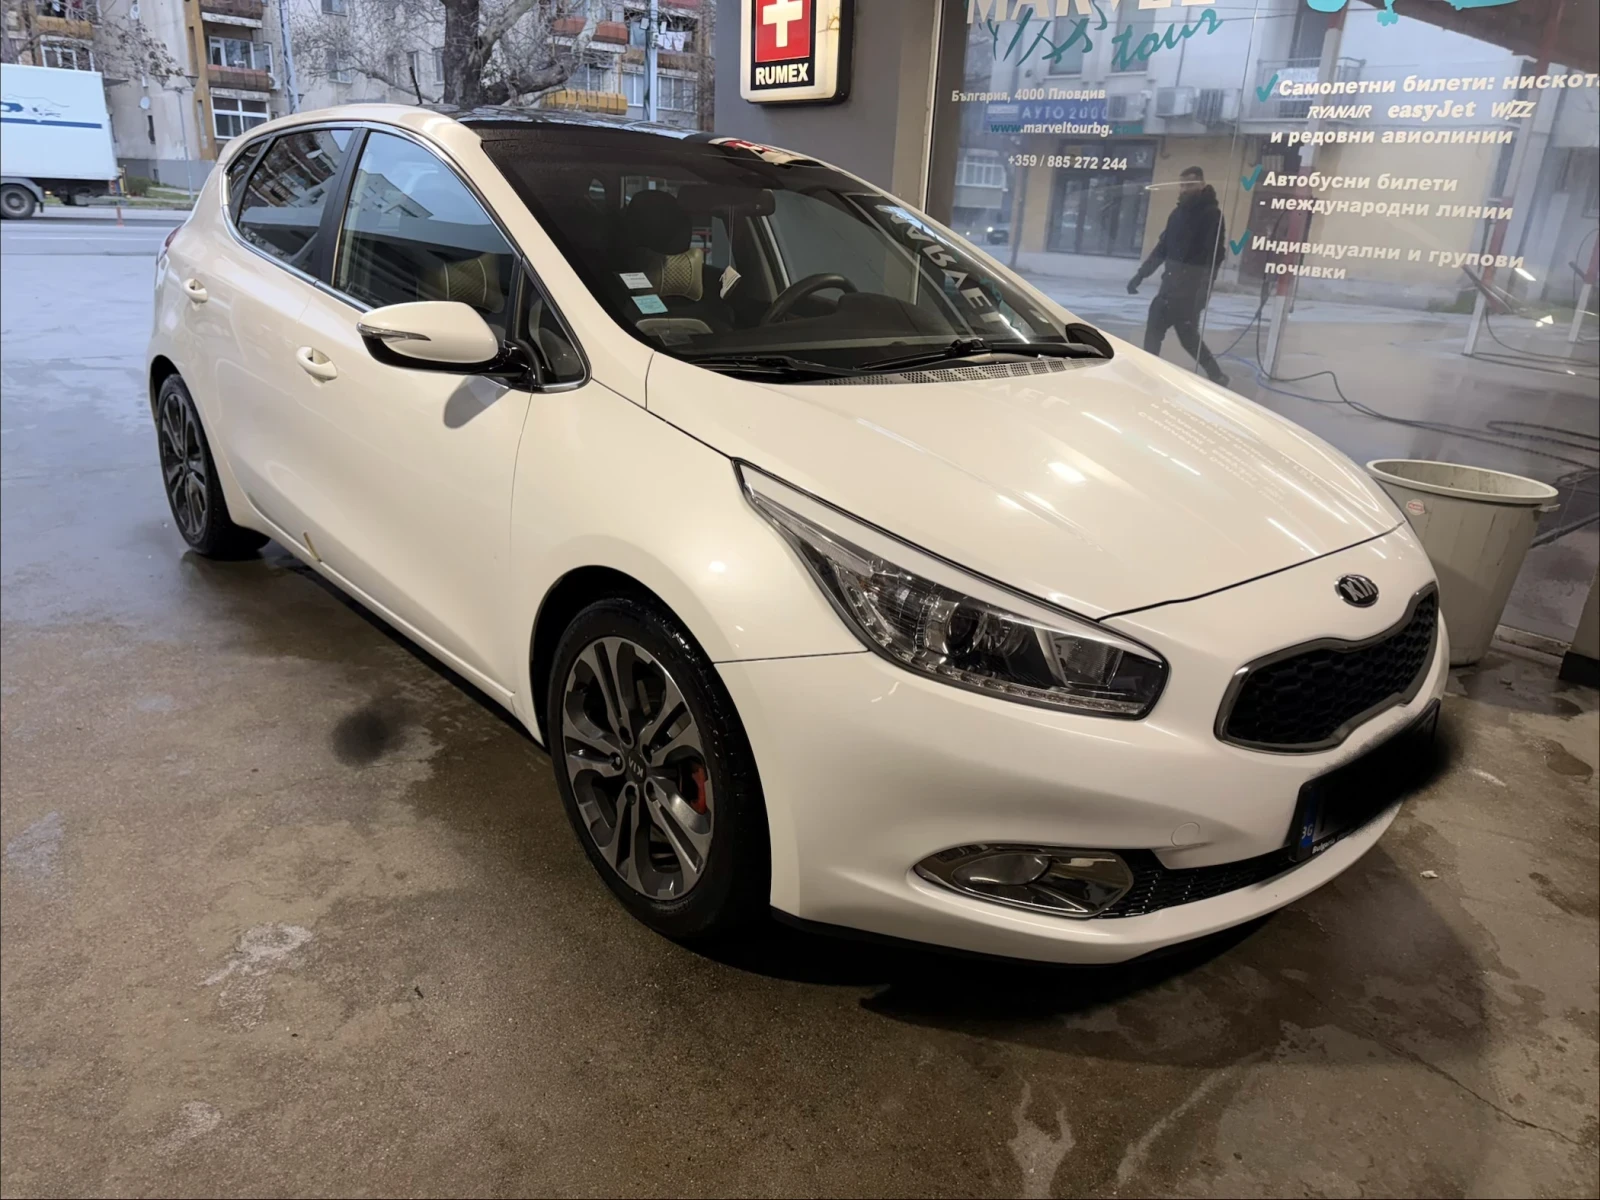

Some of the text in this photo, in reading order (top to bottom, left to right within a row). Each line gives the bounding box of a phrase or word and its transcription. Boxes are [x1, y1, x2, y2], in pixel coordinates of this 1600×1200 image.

[1111, 9, 1223, 70] tour
[755, 63, 809, 86] RUMEX
[1279, 79, 1396, 96] Самолетни
[1402, 75, 1495, 92] билети:
[1502, 73, 1599, 90] нискот
[951, 87, 1106, 104] България, 4000 Пловдив
[1306, 105, 1373, 119] RYANAIR
[1387, 100, 1477, 122] easyJet
[1270, 130, 1514, 147] и редовни авиолинии
[1008, 154, 1038, 167] +359
[1047, 155, 1071, 168] 885
[1073, 156, 1098, 170] 272
[1101, 158, 1128, 171] 244
[1263, 171, 1458, 192] Автобусни билети
[1271, 198, 1430, 217] международни
[1435, 204, 1514, 220] линии
[1251, 235, 1524, 269] Индивидуални и групови
[1264, 262, 1347, 280] почивки
[1340, 577, 1378, 602] KIA
[628, 756, 644, 778] KIA
